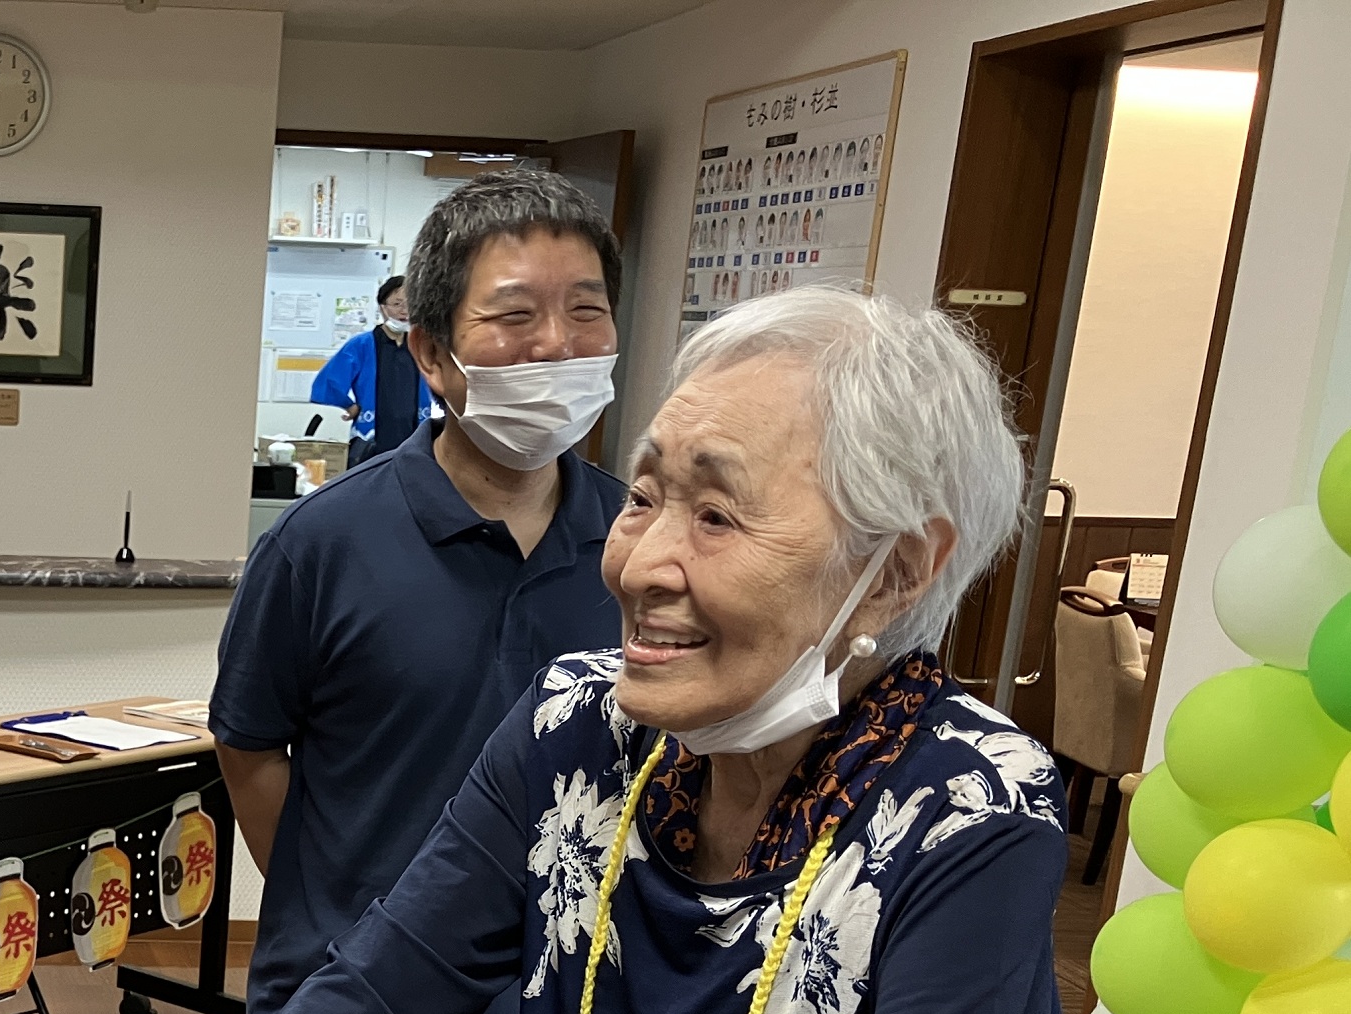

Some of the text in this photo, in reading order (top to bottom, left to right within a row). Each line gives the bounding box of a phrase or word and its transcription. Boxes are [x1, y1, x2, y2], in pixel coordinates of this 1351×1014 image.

[12, 54, 16, 69] 1
[22, 69, 31, 84] 2
[28, 89, 37, 104] 3
[20, 109, 29, 123] 4
[7, 124, 16, 138] 5
[185, 841, 215, 886] 祭
[97, 879, 131, 927] 祭
[0, 911, 36, 959] 祭
